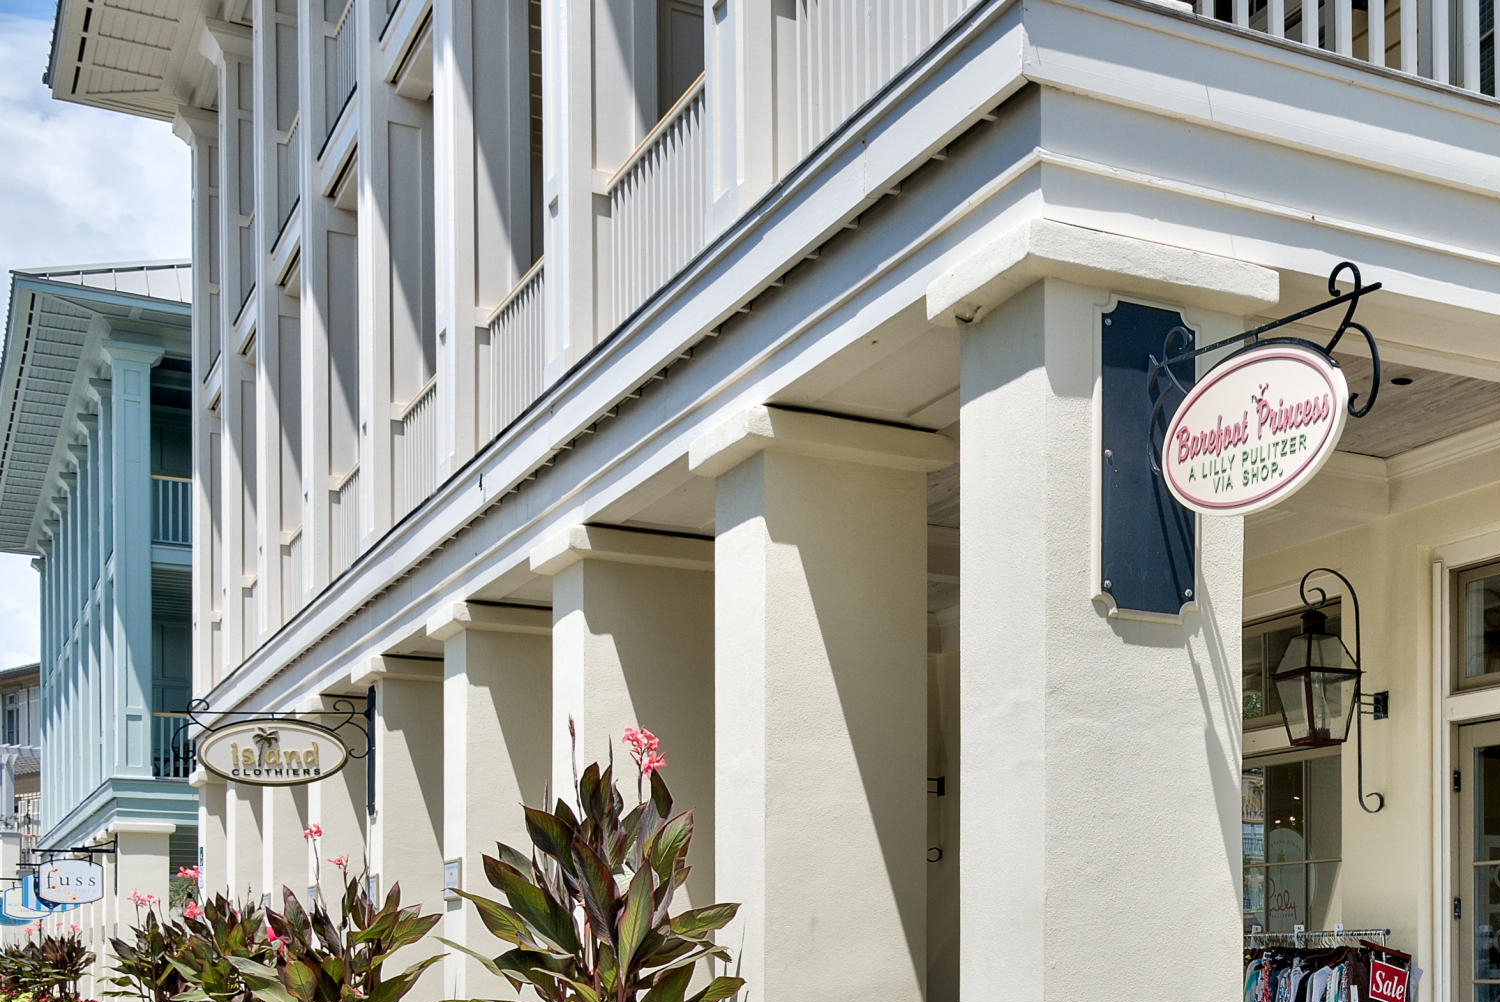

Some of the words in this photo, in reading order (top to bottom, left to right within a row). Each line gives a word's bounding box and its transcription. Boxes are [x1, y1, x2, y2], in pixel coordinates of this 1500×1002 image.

[1176, 409, 1249, 465] Barefoot
[1256, 393, 1331, 440] Princess
[1188, 466, 1197, 482] A
[1202, 453, 1236, 479] LILLY
[1241, 433, 1307, 467] PULITZER
[1213, 477, 1234, 494] VIA
[231, 768, 321, 776] CLOTHIERS
[47, 869, 96, 889] fuss
[1372, 970, 1404, 1000] Sale
